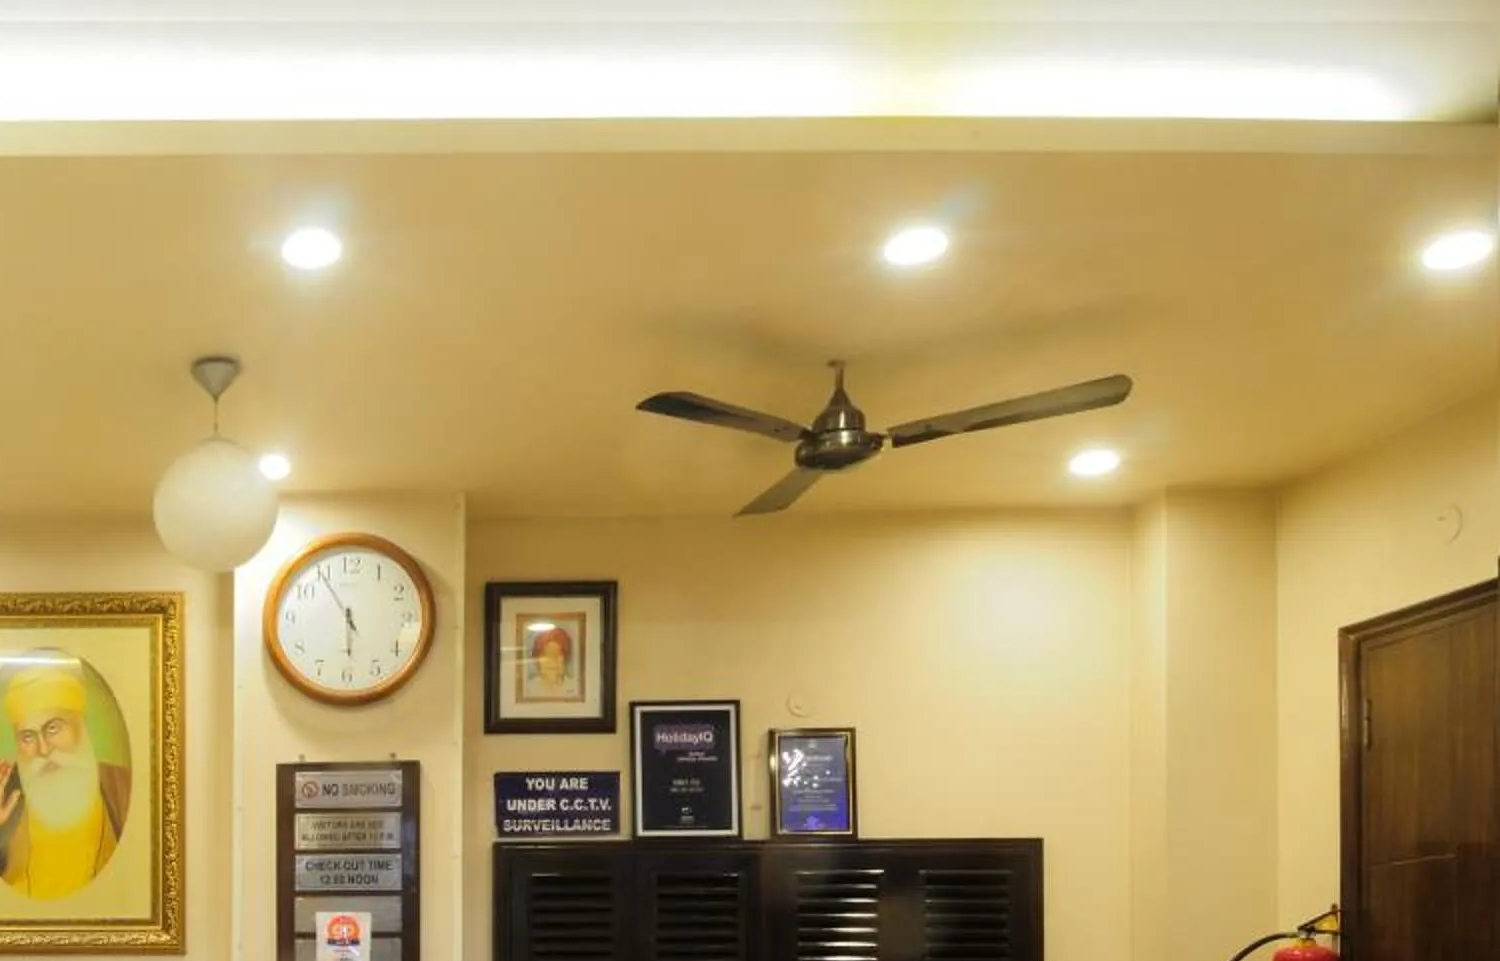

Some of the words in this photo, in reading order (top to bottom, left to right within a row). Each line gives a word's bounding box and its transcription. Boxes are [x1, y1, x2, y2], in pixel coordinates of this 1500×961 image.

[343, 556, 361, 574] 12
[297, 583, 315, 600] 10
[393, 583, 404, 601] 2
[285, 610, 295, 625] 9
[315, 659, 324, 676] 7
[341, 665, 353, 683] 6
[370, 659, 381, 676] 5
[656, 730, 713, 745] HolidayIQ
[321, 783, 339, 797] NO
[342, 782, 396, 797] SMOKING
[526, 777, 555, 791] YOU
[560, 777, 588, 790] ARE
[507, 799, 557, 811] UNDER
[560, 798, 612, 811] C.C.T.V.
[503, 819, 612, 832] SURVEILLANCE
[305, 860, 341, 871] CHECK
[343, 860, 365, 871] OUT
[368, 860, 394, 871] TIME
[347, 873, 379, 885] NOON
